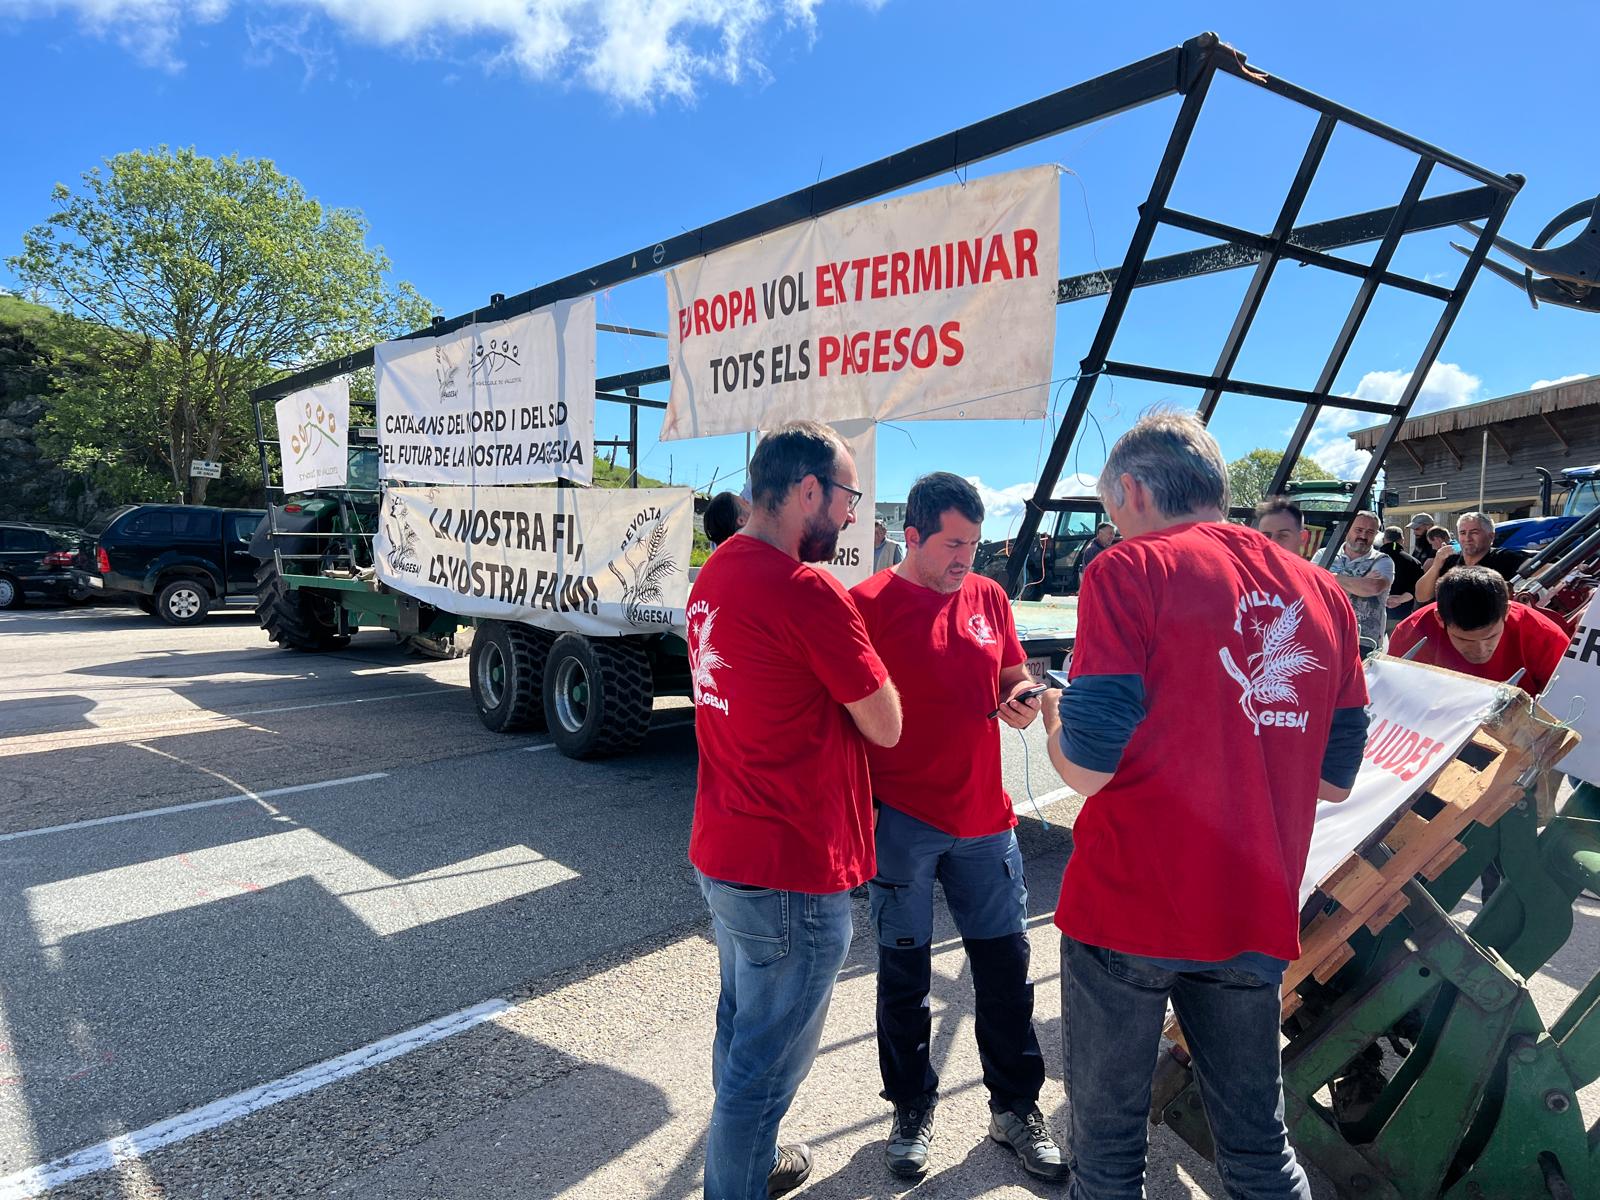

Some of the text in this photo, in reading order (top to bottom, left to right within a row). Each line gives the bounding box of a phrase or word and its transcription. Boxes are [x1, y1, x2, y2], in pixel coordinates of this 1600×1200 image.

[679, 228, 1039, 344] EUROPA VOL EXTERMINAR
[710, 321, 965, 394] TOTS ELS PAGESOS
[385, 402, 568, 436] CATALANS DEL NORD I DEL SD
[377, 444, 395, 464] PEL
[399, 445, 431, 467] FUTUR
[434, 447, 450, 468] DE
[452, 446, 465, 467] LA
[467, 444, 522, 467] NOSTRA
[429, 507, 453, 541] LA
[454, 509, 547, 552] NOSTRA
[552, 513, 584, 562] FI,
[620, 507, 662, 552] REVOLTA
[428, 554, 599, 616] LA VOSTRA FAM!
[631, 607, 674, 627] PAGESA!
[1258, 710, 1310, 734] GESA!
